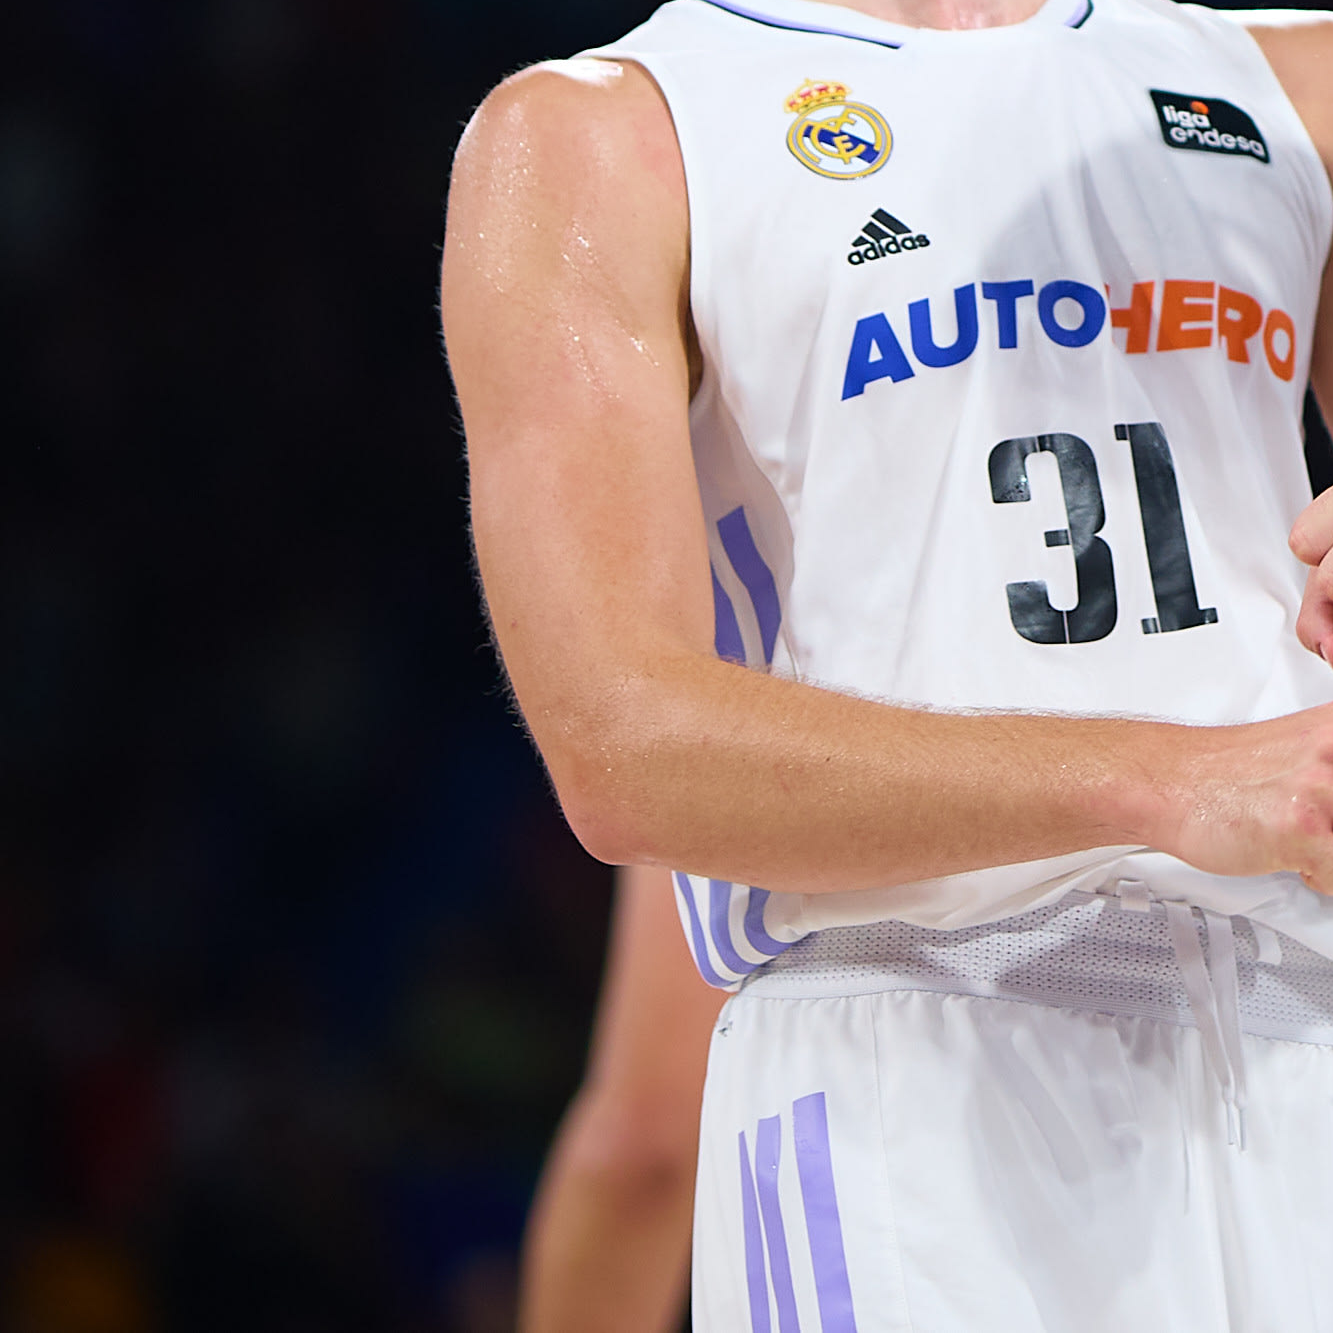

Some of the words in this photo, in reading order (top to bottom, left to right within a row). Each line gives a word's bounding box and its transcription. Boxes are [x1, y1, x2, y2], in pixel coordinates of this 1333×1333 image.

[1162, 104, 1211, 128] liga
[1170, 127, 1266, 157] endesa
[847, 234, 930, 265] adidas
[841, 279, 1296, 401] AUTOHERO
[988, 422, 1218, 644] 31
